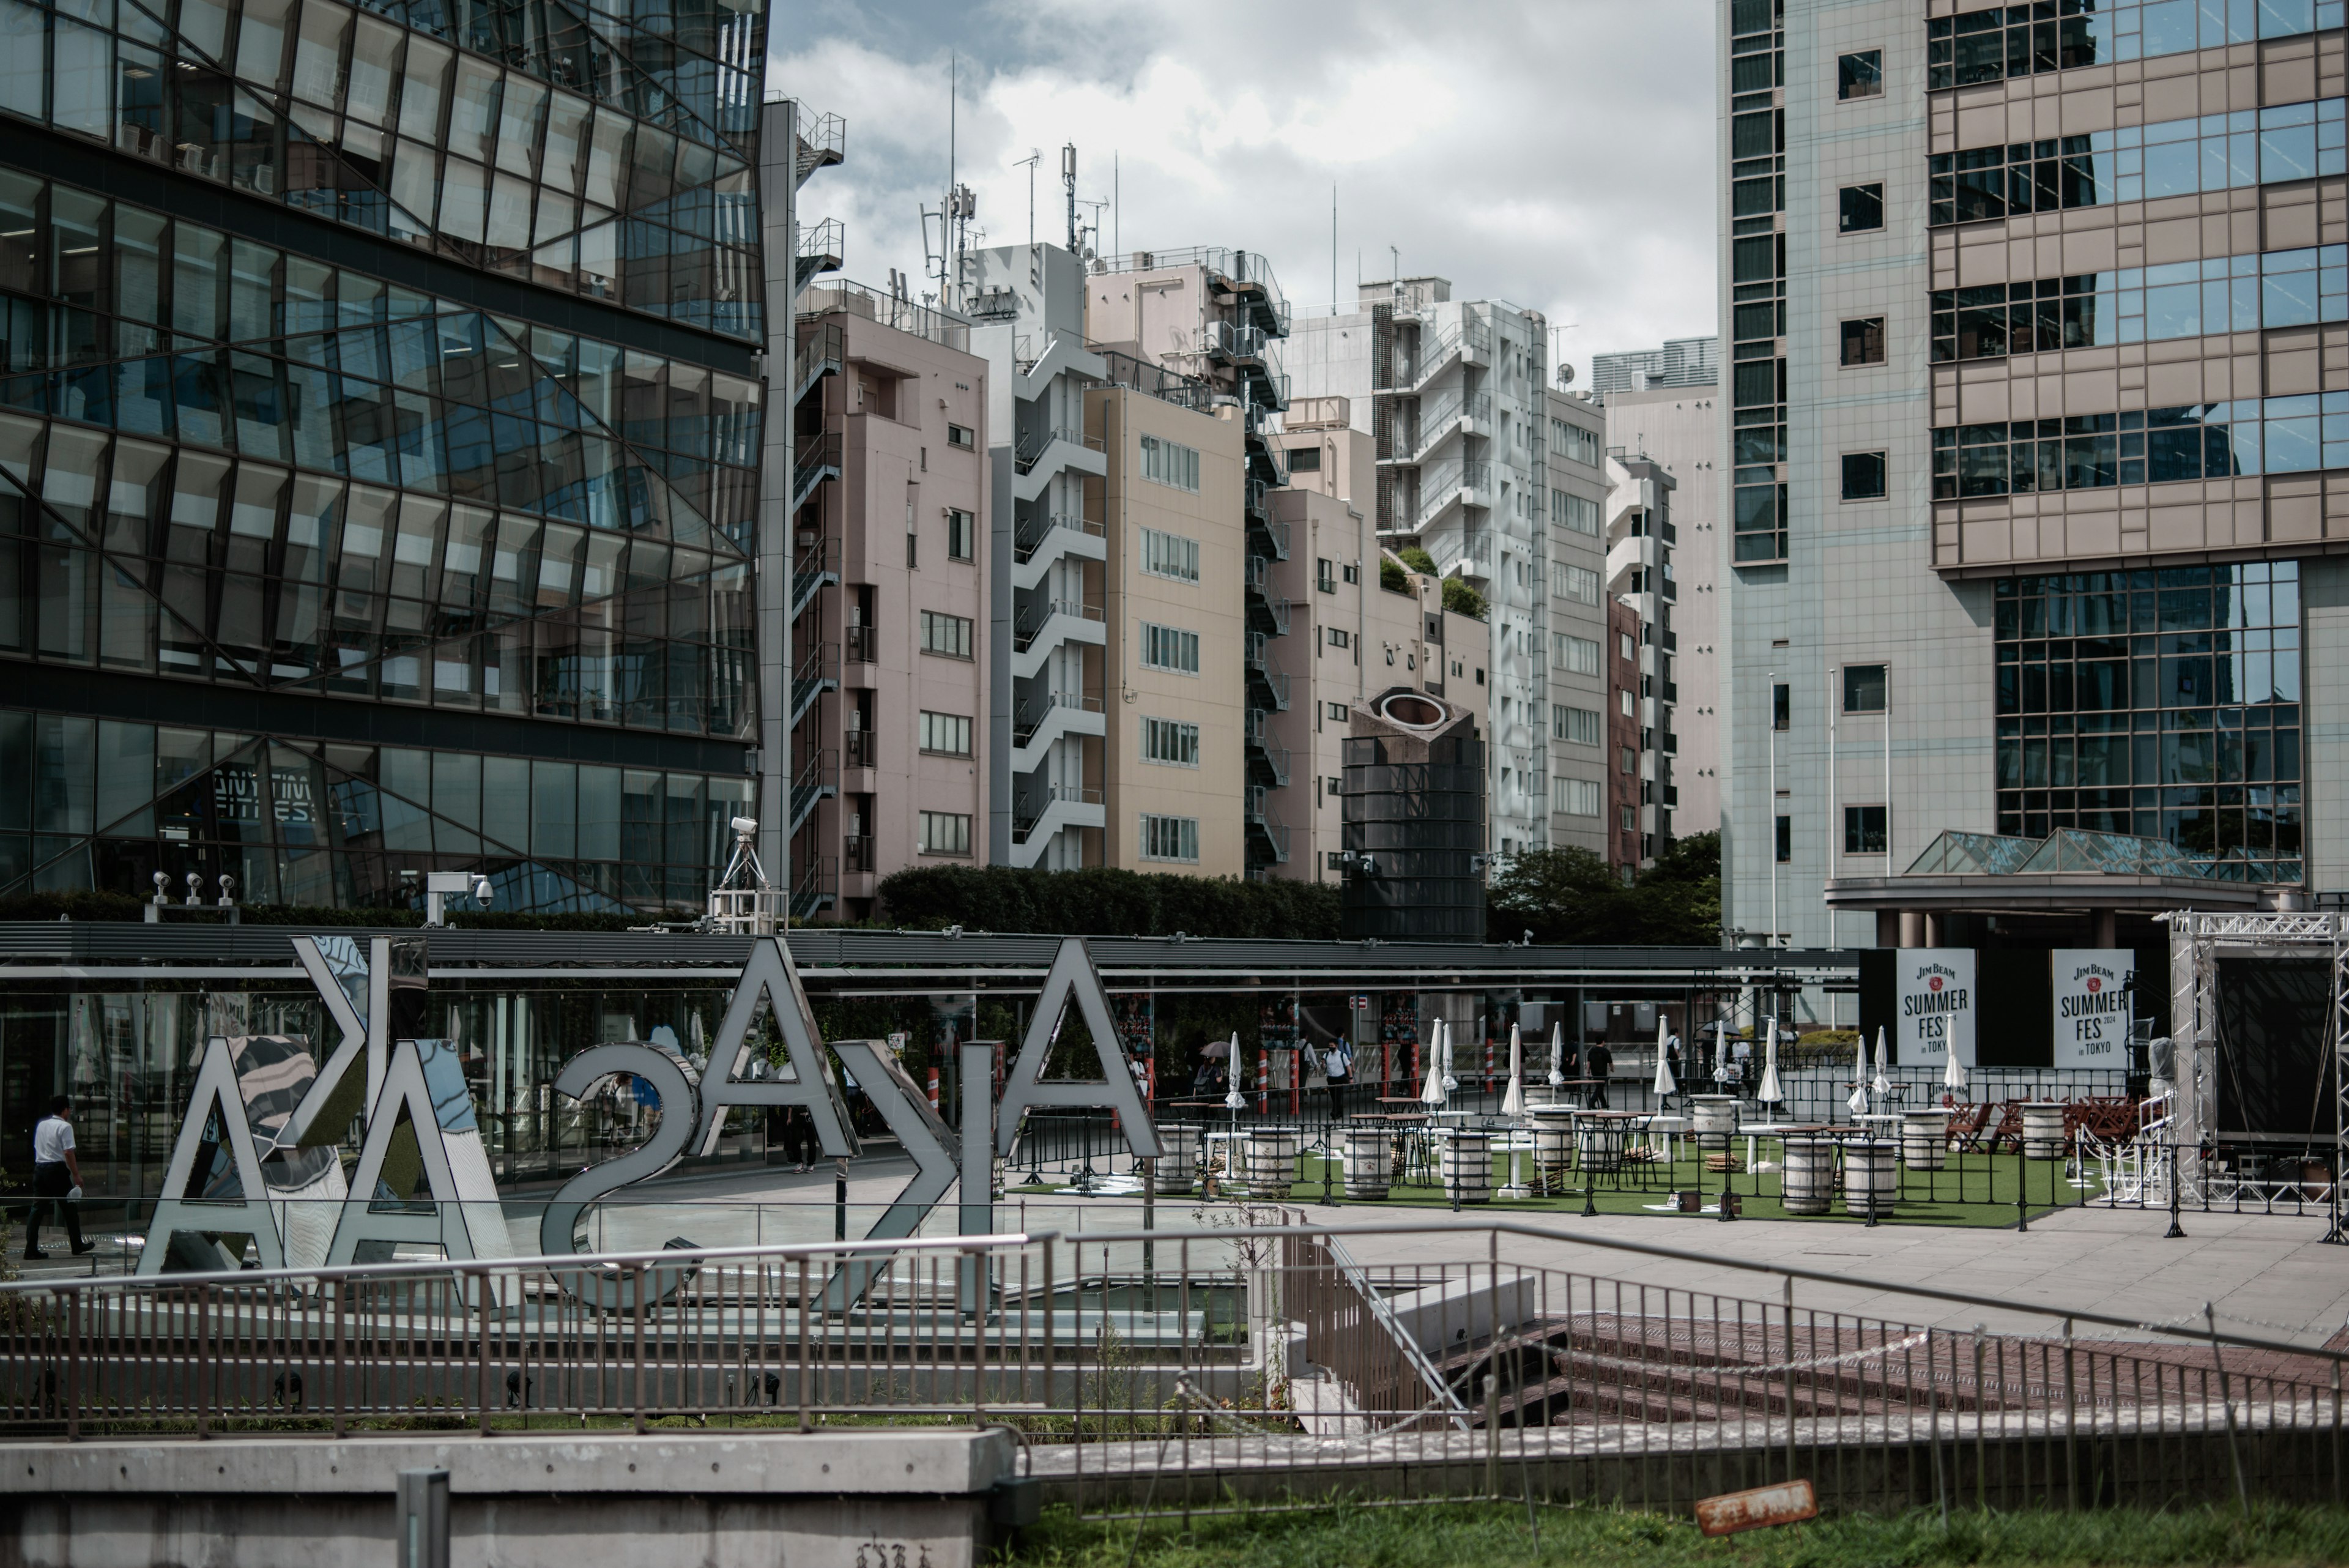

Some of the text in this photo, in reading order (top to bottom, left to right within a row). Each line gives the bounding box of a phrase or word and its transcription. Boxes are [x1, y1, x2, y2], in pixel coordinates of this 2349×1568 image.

[213, 768, 311, 800] ANYTIM
[1917, 963, 1956, 980] JIM BEAM
[2074, 964, 2114, 981] JIM BEAM
[1904, 989, 1968, 1016] SUMMER
[2061, 990, 2128, 1018] SUMMER
[1919, 1016, 1943, 1039] FES
[2076, 1016, 2116, 1041] FES 2024
[1928, 1039, 1947, 1053] TOKY
[2085, 1041, 2111, 1055] TOKYO
